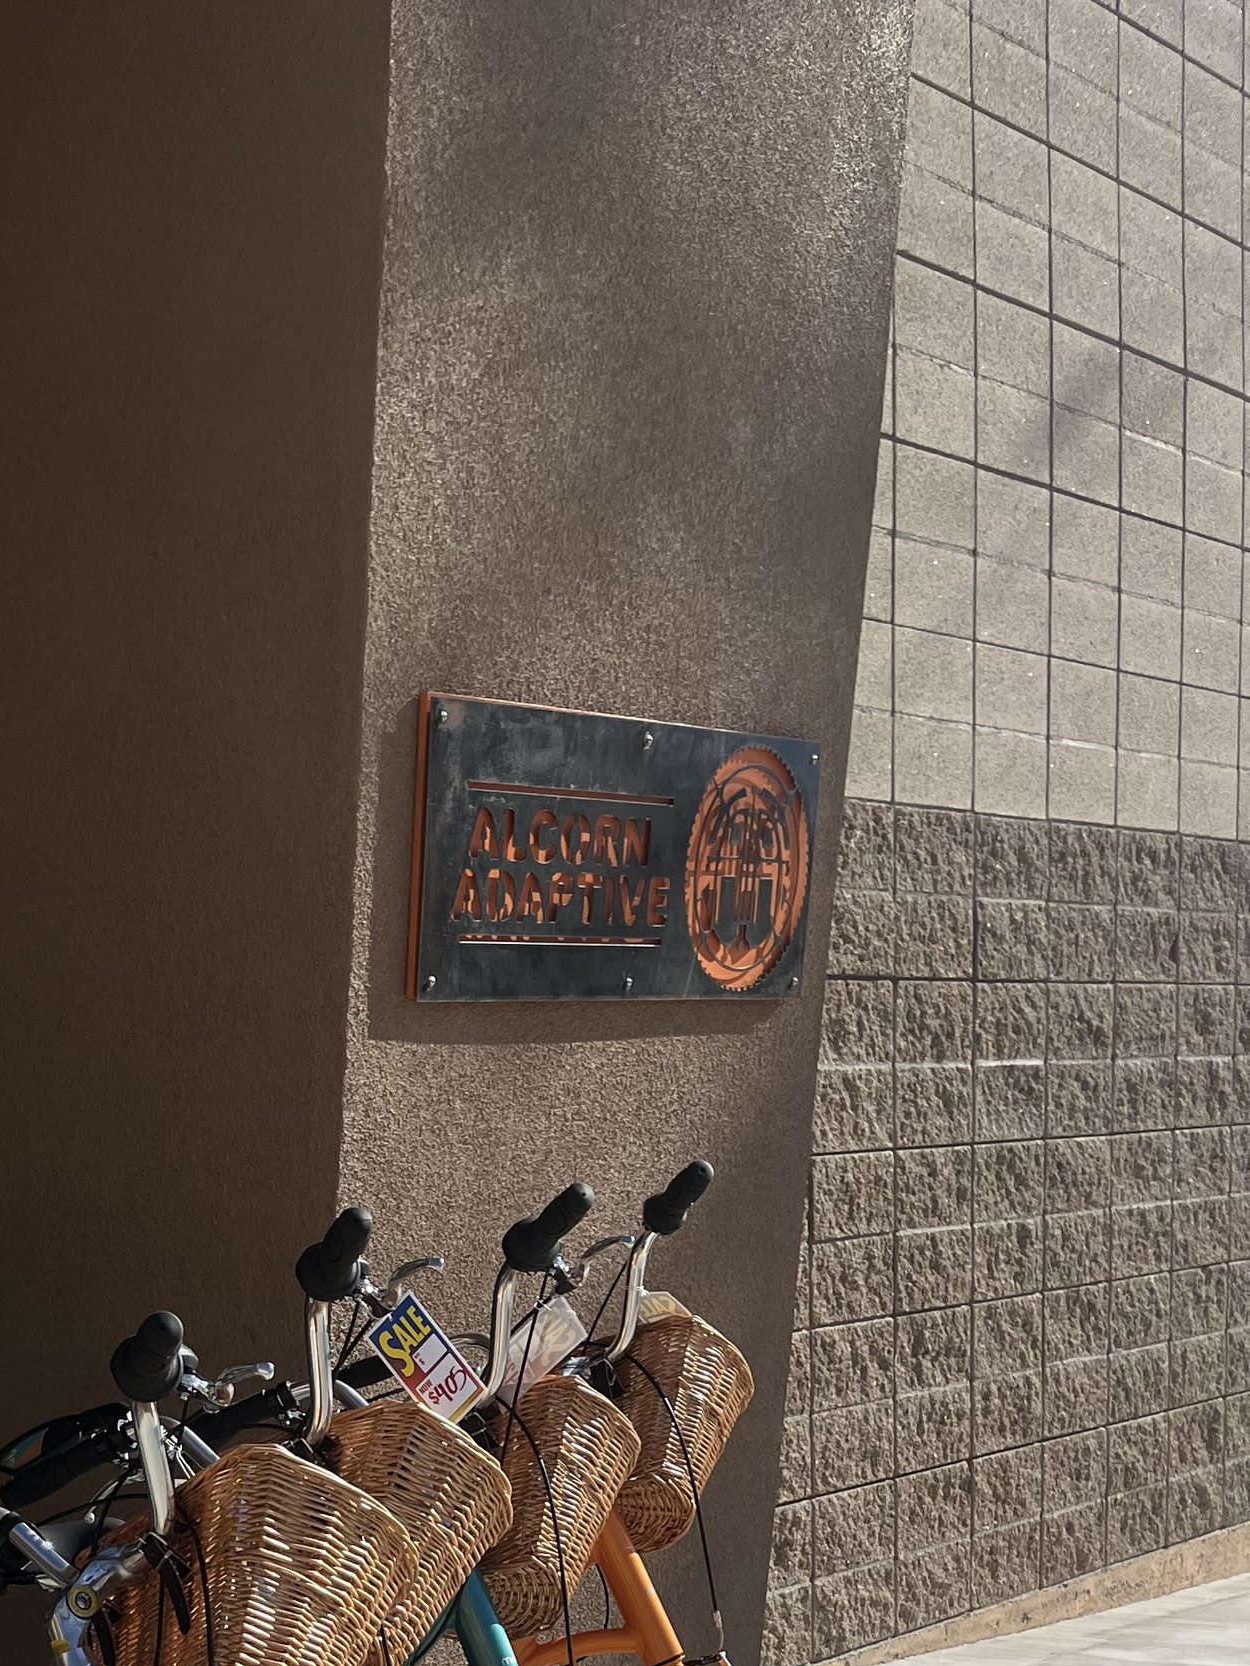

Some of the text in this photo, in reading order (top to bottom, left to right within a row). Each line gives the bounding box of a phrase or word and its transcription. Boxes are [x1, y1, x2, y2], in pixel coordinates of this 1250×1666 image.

[468, 806, 651, 868] ALCORN
[451, 868, 671, 928] ADAPTIVE
[378, 1305, 431, 1377] SALE
[418, 1379, 433, 1394] NOW
